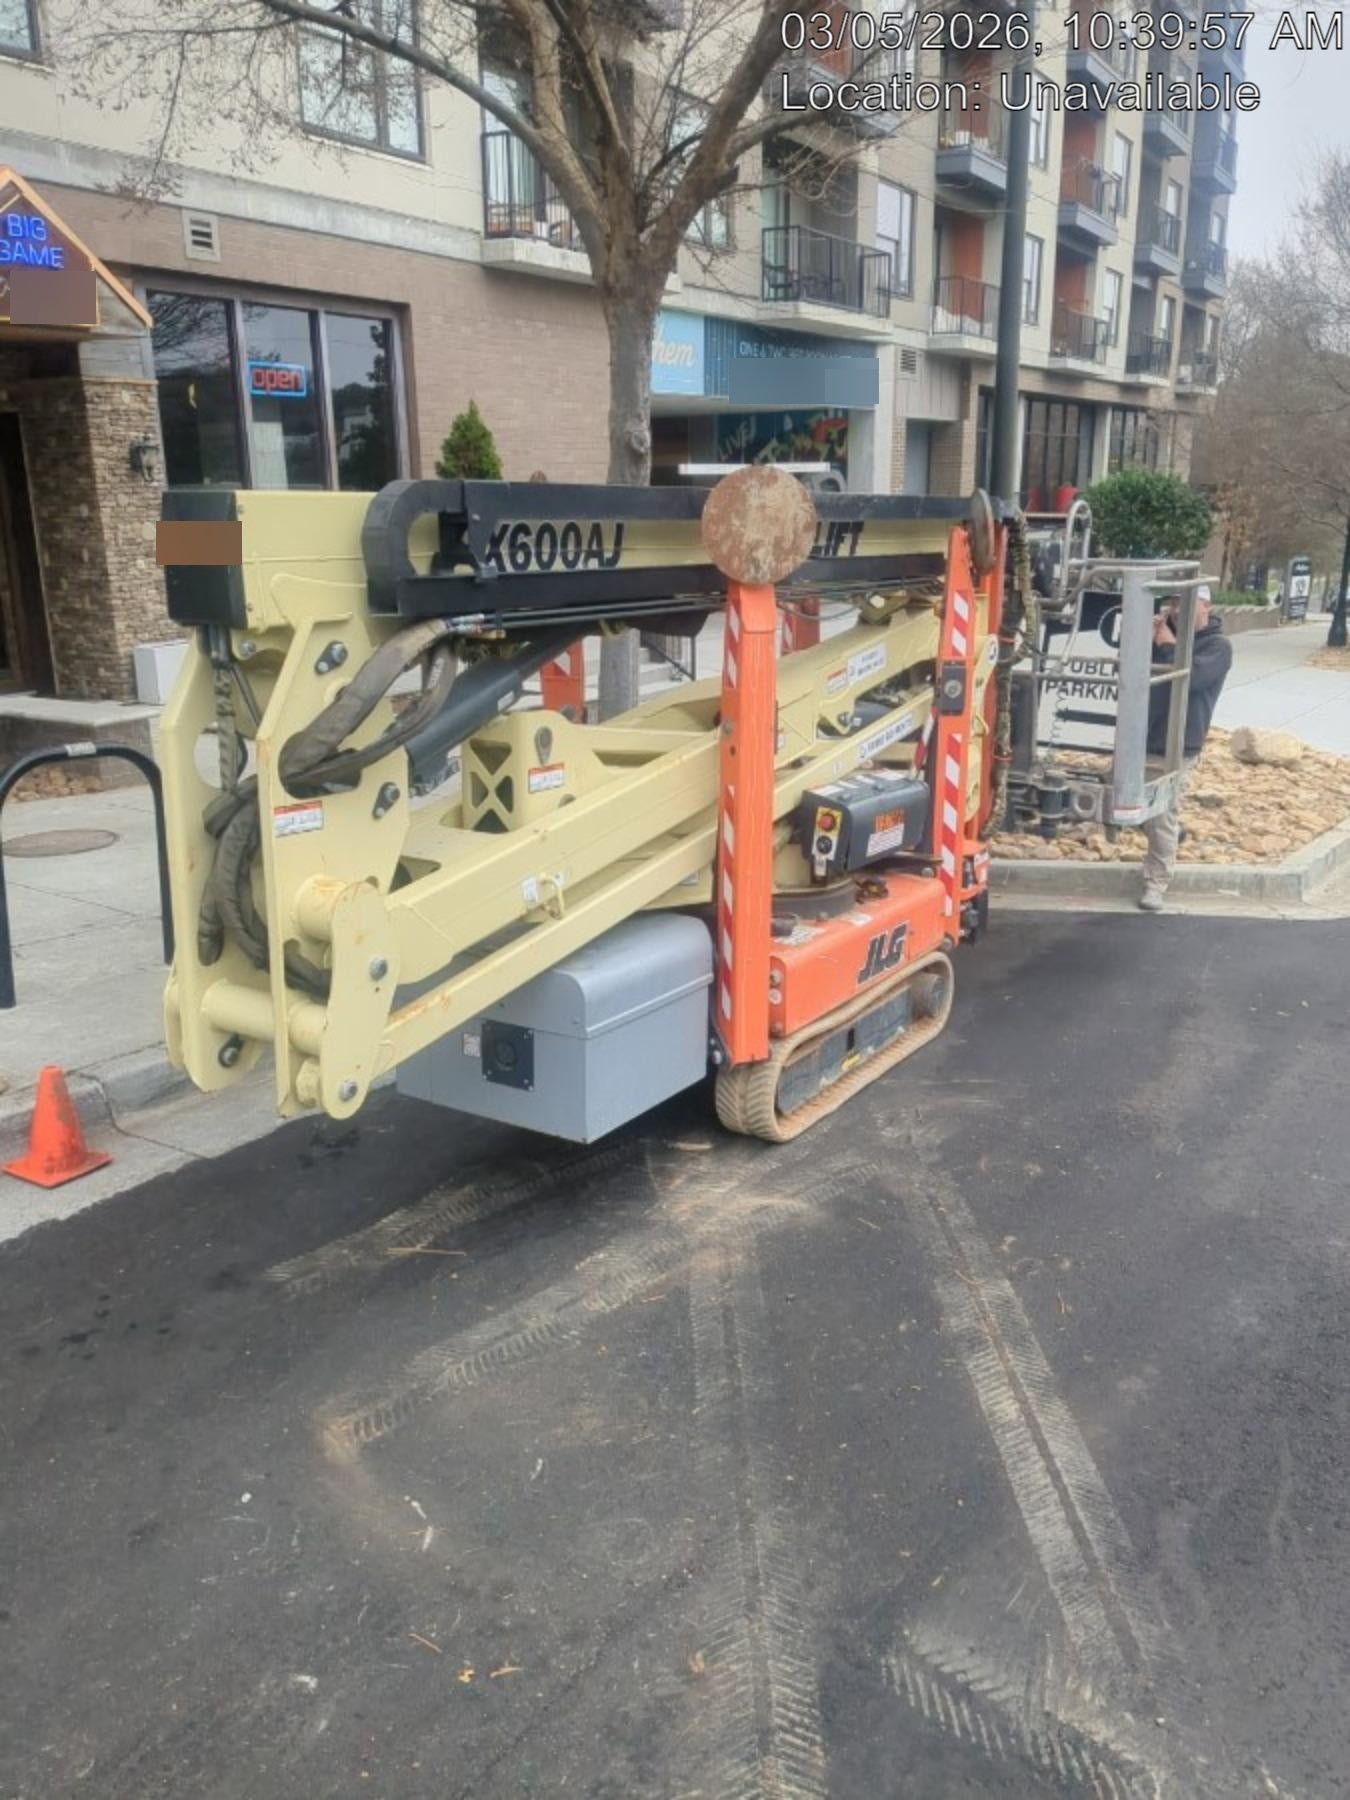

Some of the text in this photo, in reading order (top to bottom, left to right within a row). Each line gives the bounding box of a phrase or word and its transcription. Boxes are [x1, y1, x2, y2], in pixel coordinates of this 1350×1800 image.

[7, 213, 47, 241] BIG
[0, 239, 64, 269] GAME
[252, 368, 303, 392] open
[1044, 680, 1119, 702] PARKIN
[857, 923, 908, 985] JLG
